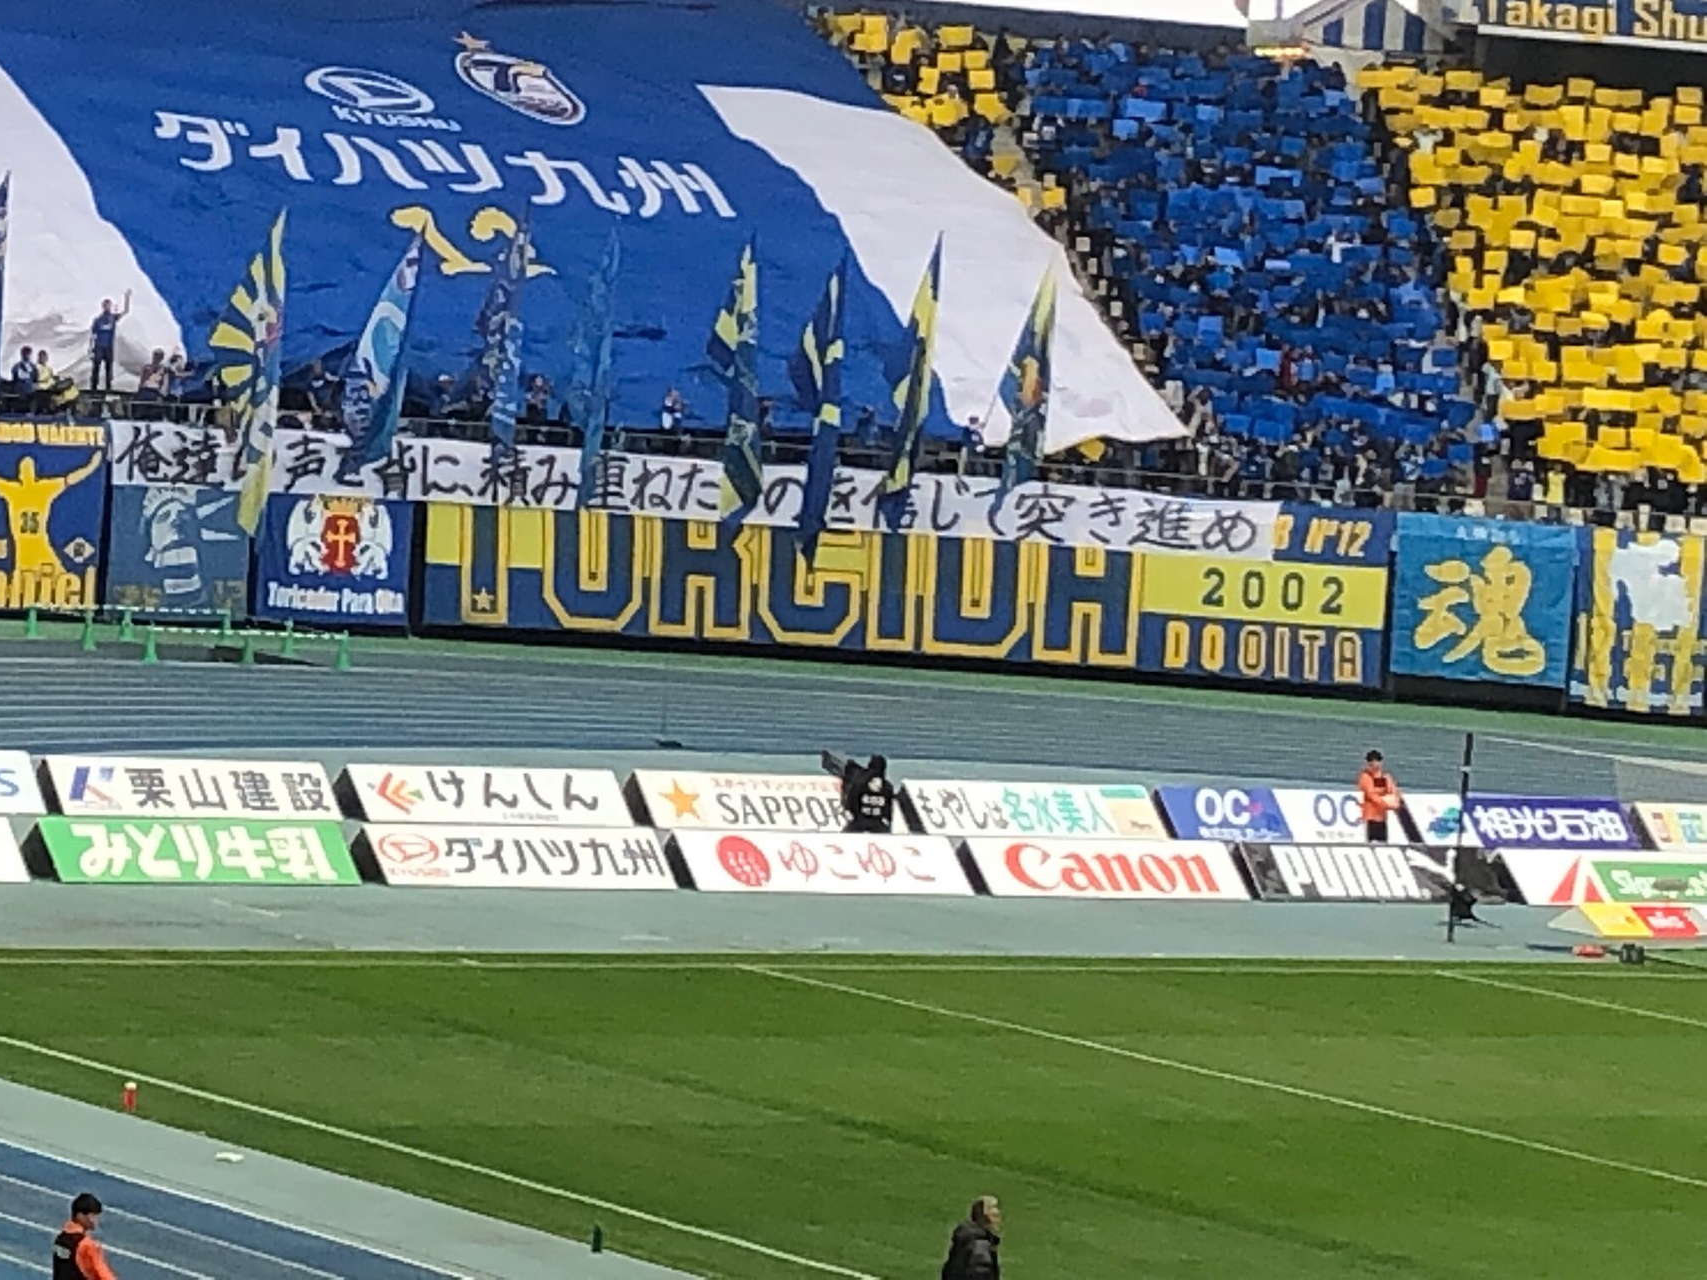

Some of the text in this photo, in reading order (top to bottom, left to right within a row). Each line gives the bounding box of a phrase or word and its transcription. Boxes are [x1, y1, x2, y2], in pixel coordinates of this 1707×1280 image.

[154, 110, 736, 218] ダイハツ九州
[1200, 566, 1345, 616] 2002
[1413, 545, 1546, 676] 魂
[426, 770, 599, 811] けんしん
[715, 792, 845, 827] SAPPOR
[1196, 787, 1251, 826] OC
[1472, 804, 1629, 841] 相光石油
[70, 821, 339, 883] みどり牛乳
[443, 837, 667, 878] ダイハツ九州
[780, 839, 937, 884] ゆこゆこ
[1004, 841, 1222, 895] Canon
[1276, 845, 1422, 898] PUMA
